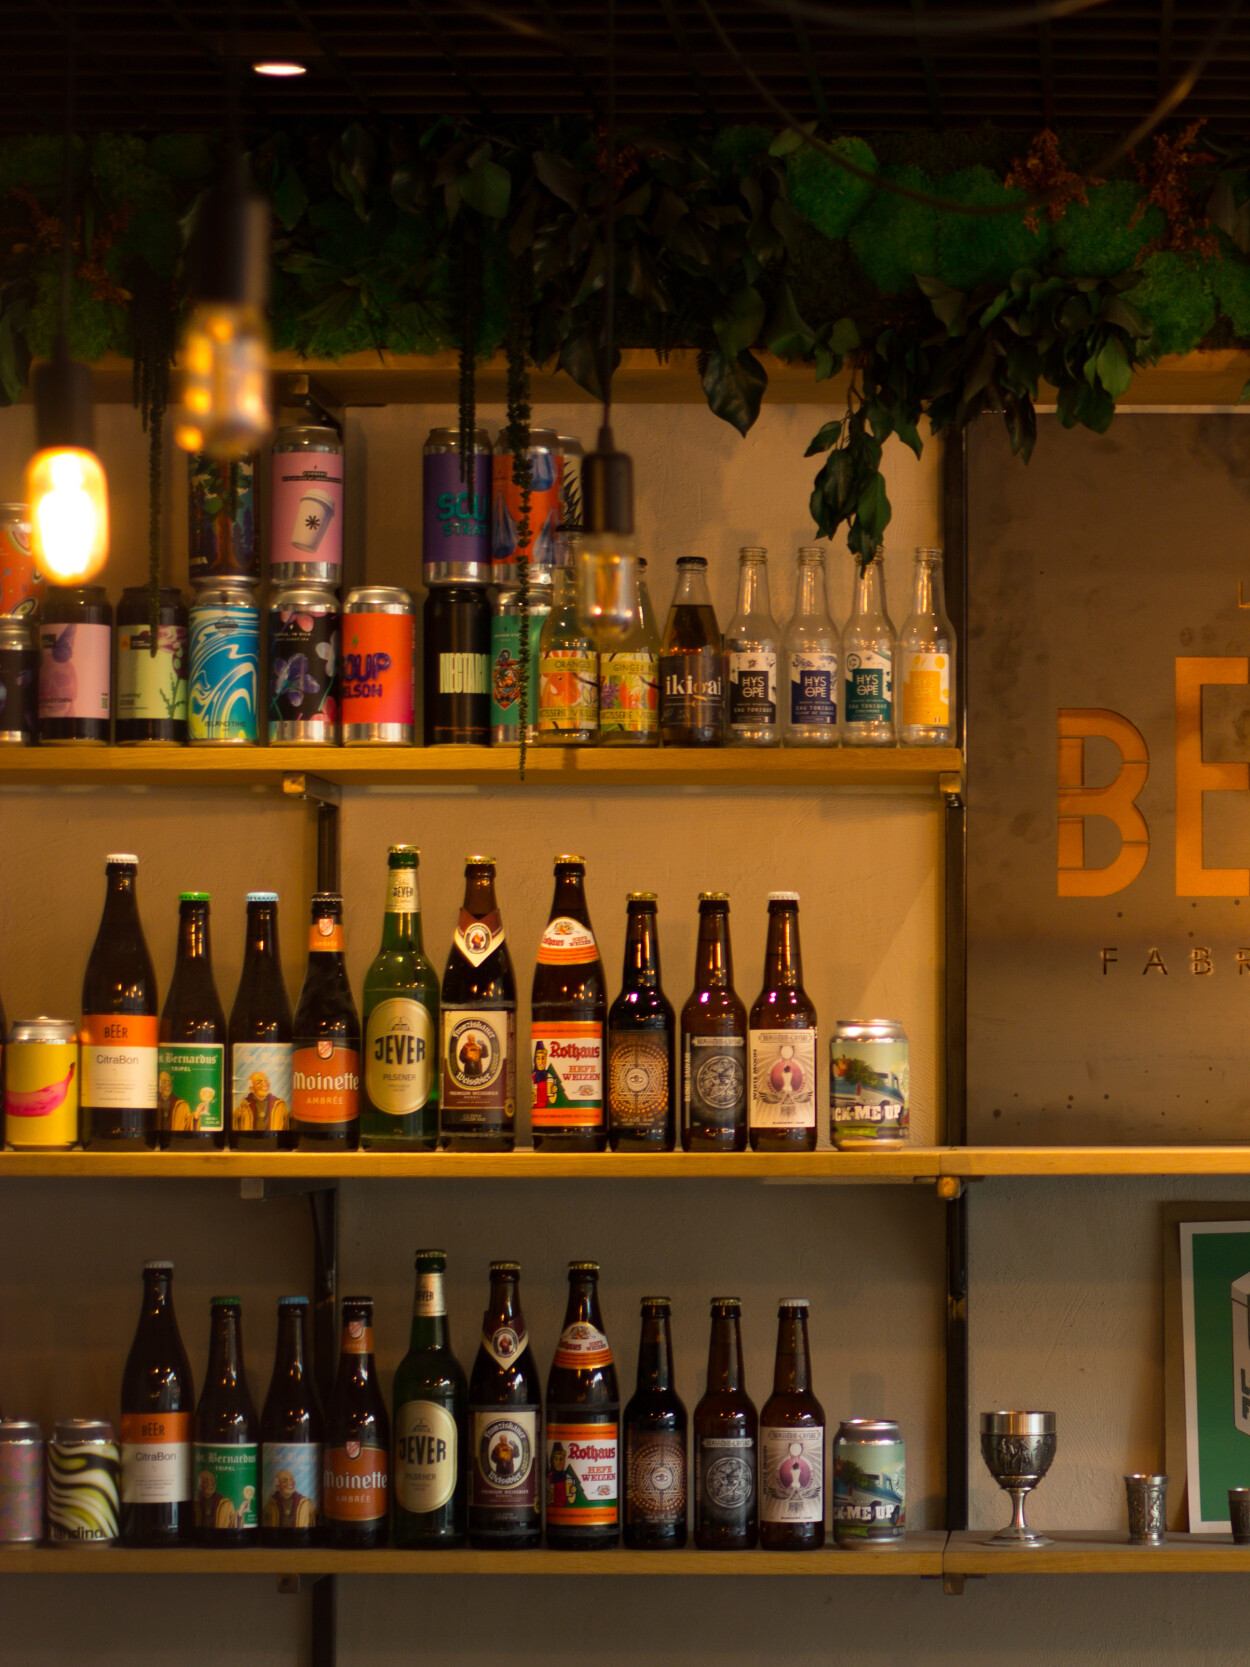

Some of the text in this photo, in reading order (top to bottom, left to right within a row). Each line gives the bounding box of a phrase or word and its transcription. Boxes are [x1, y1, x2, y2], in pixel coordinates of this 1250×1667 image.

[342, 652, 391, 683] OUP
[742, 676, 764, 687] HYS
[804, 676, 826, 687] HYS
[856, 674, 878, 685] HYS
[342, 684, 383, 699] ELSON
[104, 1024, 128, 1038] BEER
[374, 1035, 425, 1065] JEVER
[549, 1041, 600, 1061] Rothaus
[96, 1054, 138, 1065] CitraBon
[165, 1053, 217, 1064] Bernardus
[569, 1065, 596, 1073] HEFE
[293, 1071, 359, 1091] Moinette
[383, 1073, 416, 1081] PILSENER
[562, 1073, 600, 1081] WEIZEN
[306, 1095, 344, 1105] AMBRÉE
[884, 1104, 901, 1120] UP
[141, 1423, 165, 1437] BEER
[484, 1420, 526, 1440] Franziskaner
[136, 1451, 177, 1462] CitraBon
[208, 1451, 256, 1463] Bernardus
[399, 1436, 447, 1465] JEVER
[568, 1443, 616, 1462] Rothaus
[588, 1466, 612, 1474] HEFE
[324, 1470, 388, 1490] Moinette
[488, 1471, 522, 1486] Weissbier
[581, 1473, 616, 1482] WEIZEN
[336, 1494, 371, 1503] AMBRÉE
[847, 1505, 872, 1520] ME
[875, 1504, 895, 1520] UP
